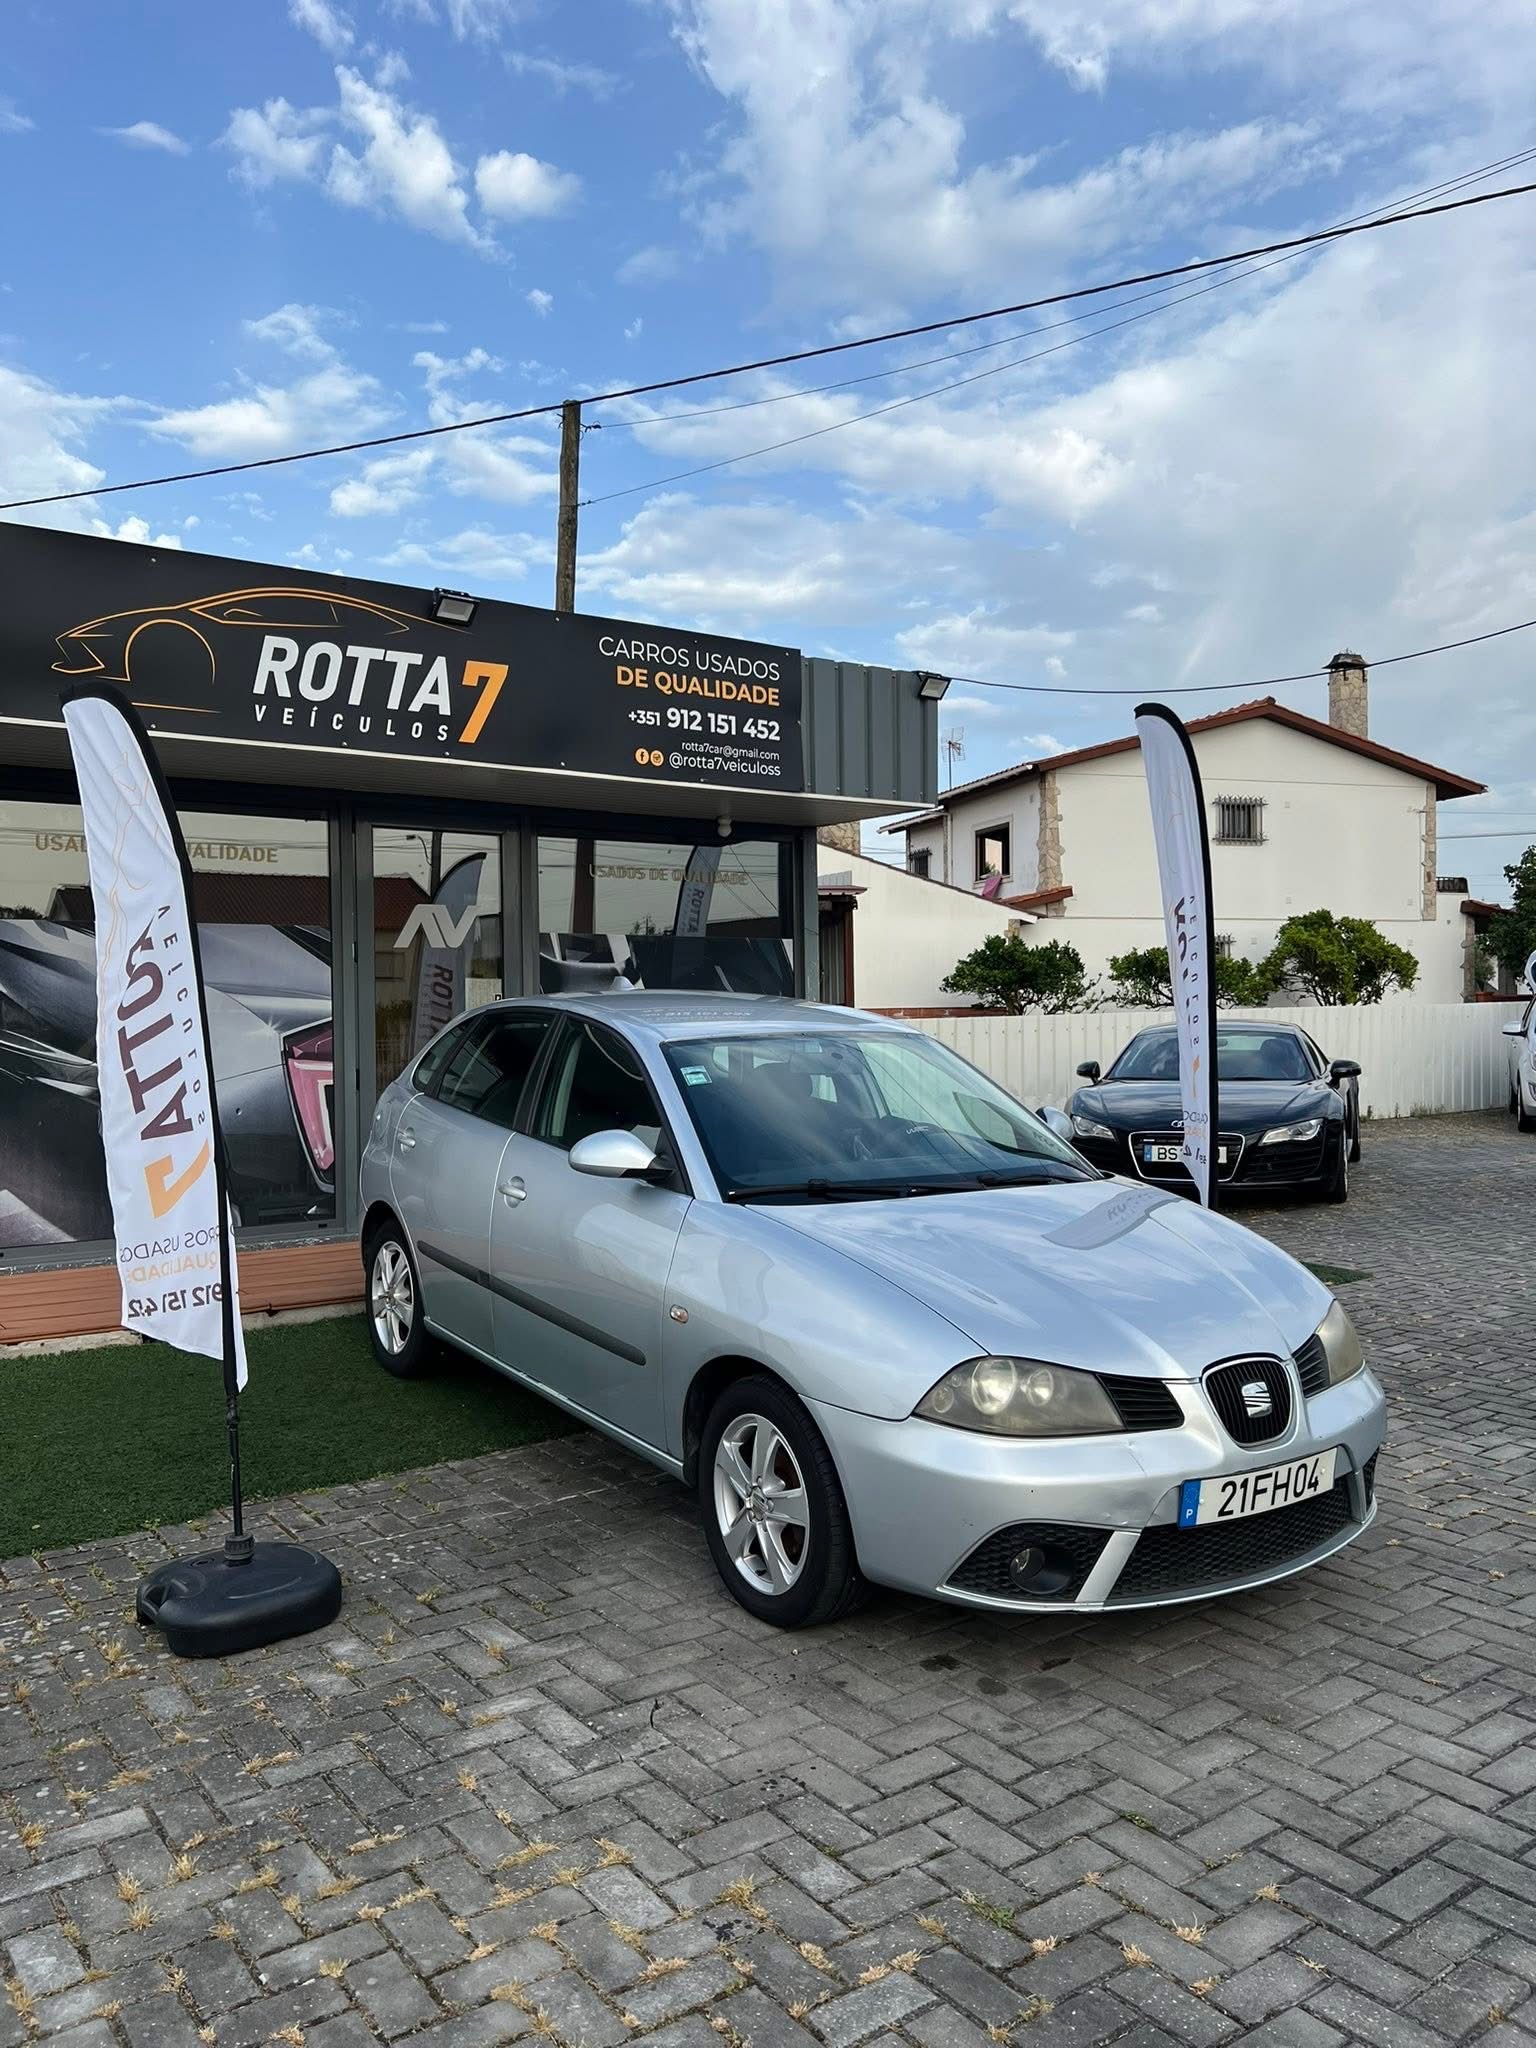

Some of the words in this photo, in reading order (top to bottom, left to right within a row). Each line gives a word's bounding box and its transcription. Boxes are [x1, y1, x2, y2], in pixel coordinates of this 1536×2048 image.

[599, 636, 690, 668] CARROS
[696, 650, 780, 681] USADOS
[253, 635, 451, 716] ROTTA
[459, 660, 509, 743] 7
[616, 665, 649, 688] DE
[654, 671, 780, 707] QUALIDADE
[254, 704, 449, 741] VEÍCULOS
[628, 709, 661, 726] +351
[666, 707, 703, 732] 912
[707, 712, 737, 736] 151
[743, 718, 781, 741] 452
[669, 752, 781, 776] @rotta7veiculoss
[681, 741, 780, 761] rotta7car@gmail.com
[1217, 1458, 1320, 1518] 21FH04
